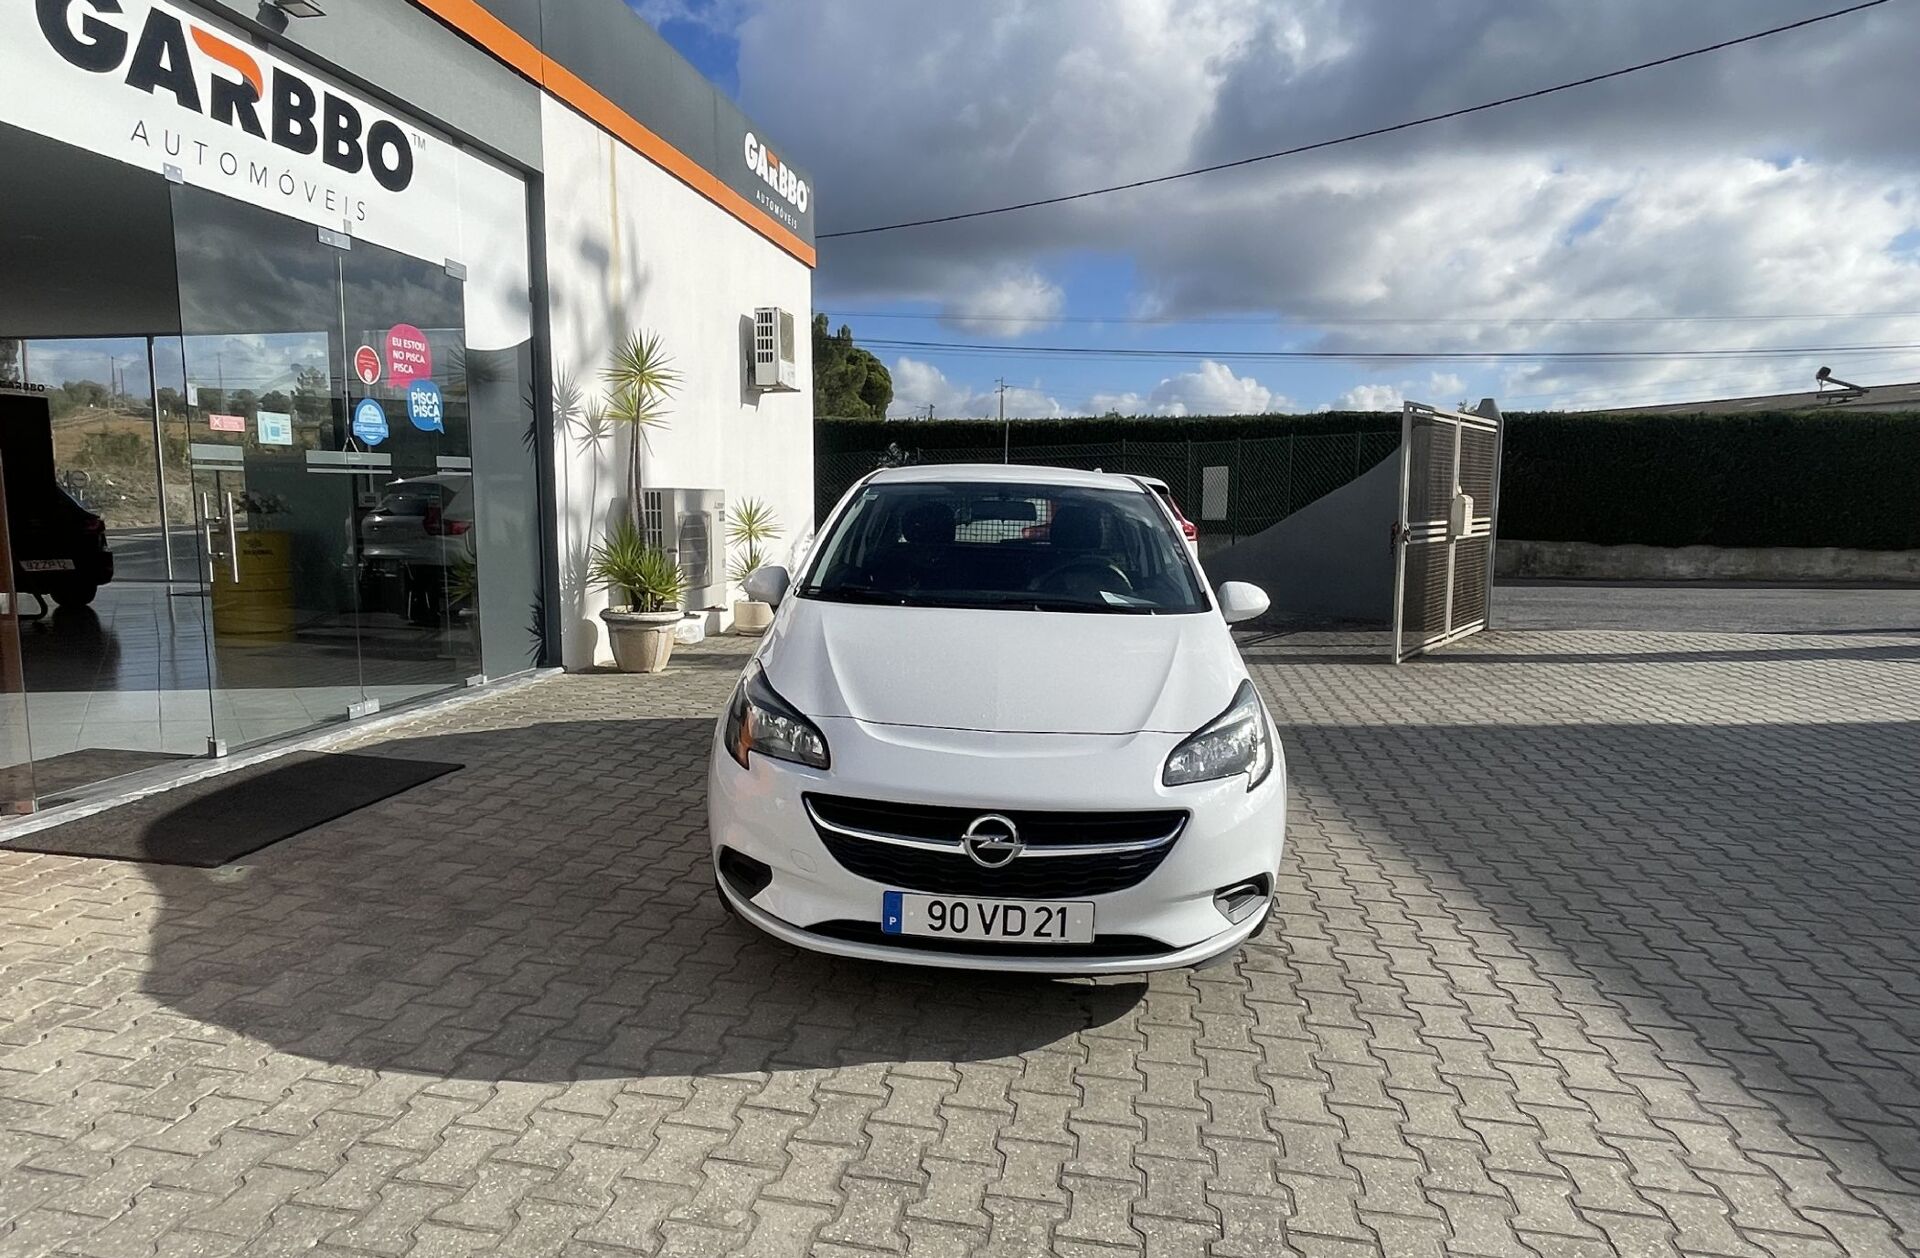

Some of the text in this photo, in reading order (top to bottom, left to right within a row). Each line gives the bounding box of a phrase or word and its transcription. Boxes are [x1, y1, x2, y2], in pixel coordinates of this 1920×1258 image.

[36, 0, 413, 192] GARBBO
[130, 119, 366, 222] AUTOMÓVEIS
[744, 131, 808, 214] GARBBO
[392, 336, 425, 352] EU ESTOU
[392, 350, 426, 364] NO PISCA
[393, 362, 414, 374] PISCA
[411, 388, 439, 404] PISCA
[413, 404, 440, 417] PISCA
[889, 916, 897, 926] P
[928, 900, 1068, 938] 90 VD 21
